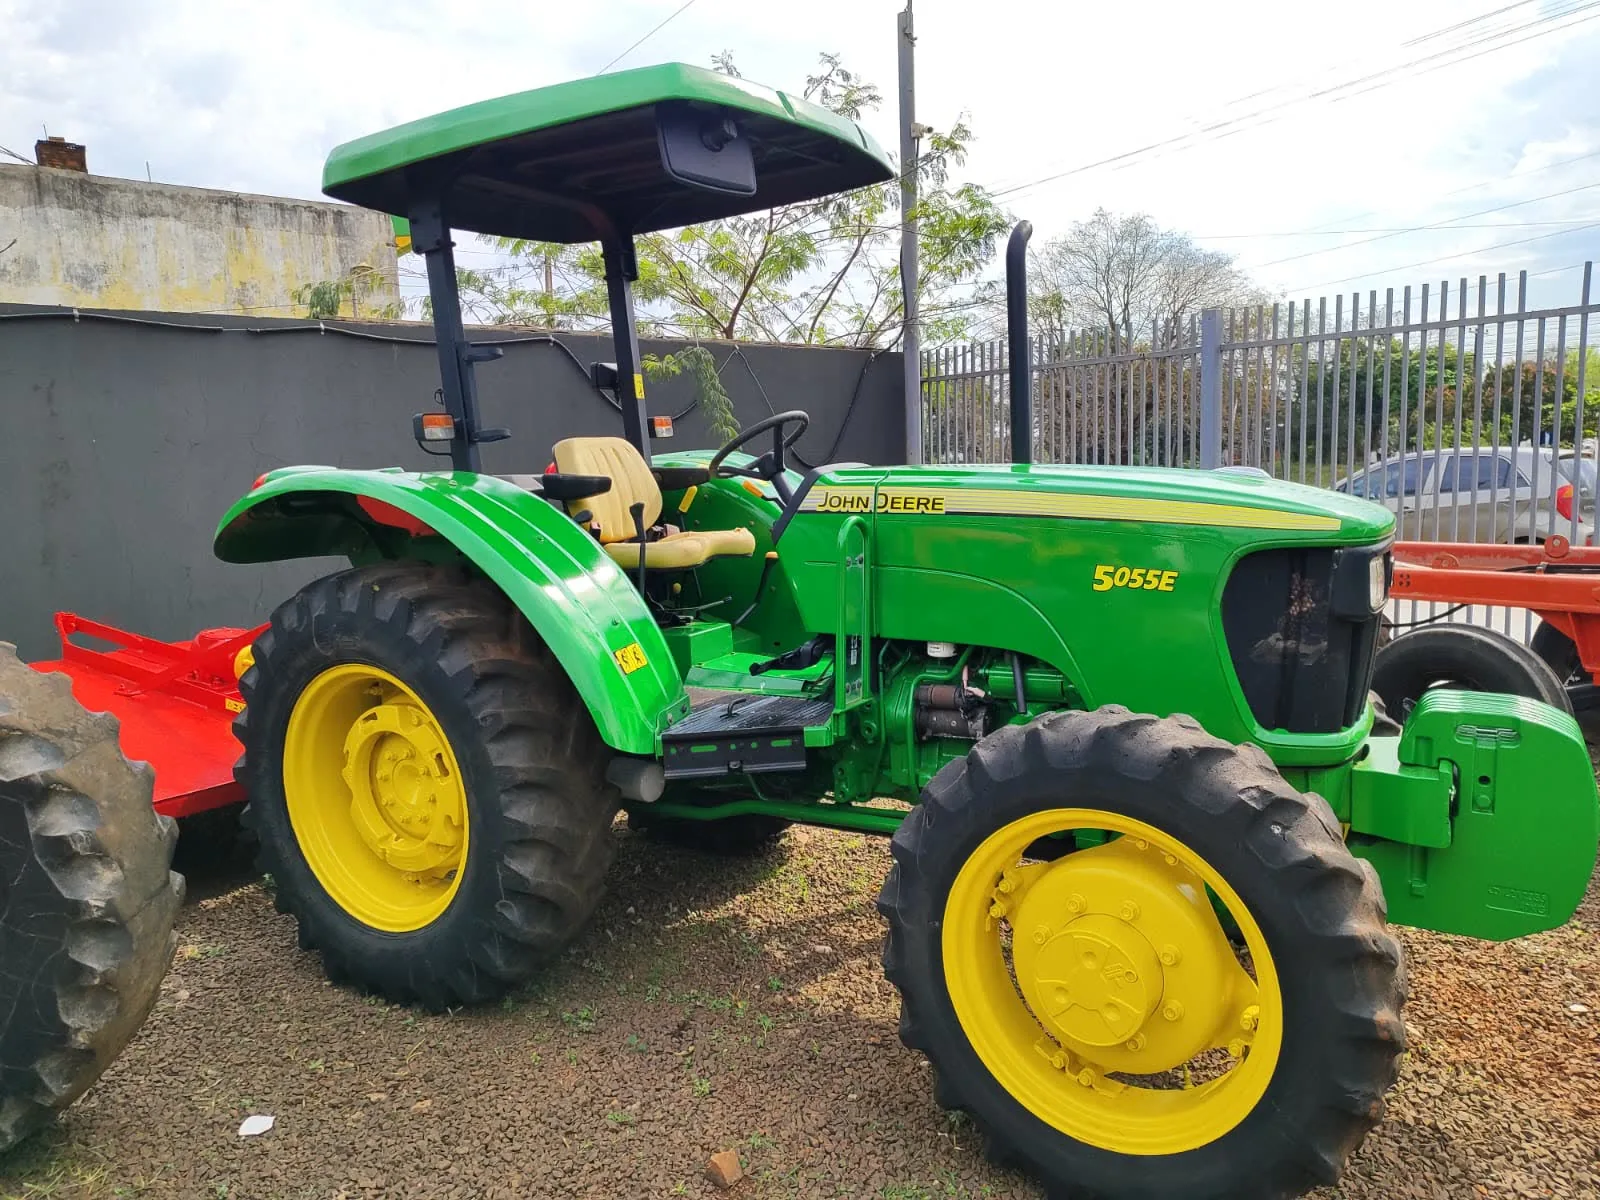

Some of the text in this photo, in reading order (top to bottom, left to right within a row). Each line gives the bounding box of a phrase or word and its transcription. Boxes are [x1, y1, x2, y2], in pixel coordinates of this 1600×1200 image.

[818, 491, 945, 511] JOHN DEERE
[1092, 564, 1179, 592] 5055E
